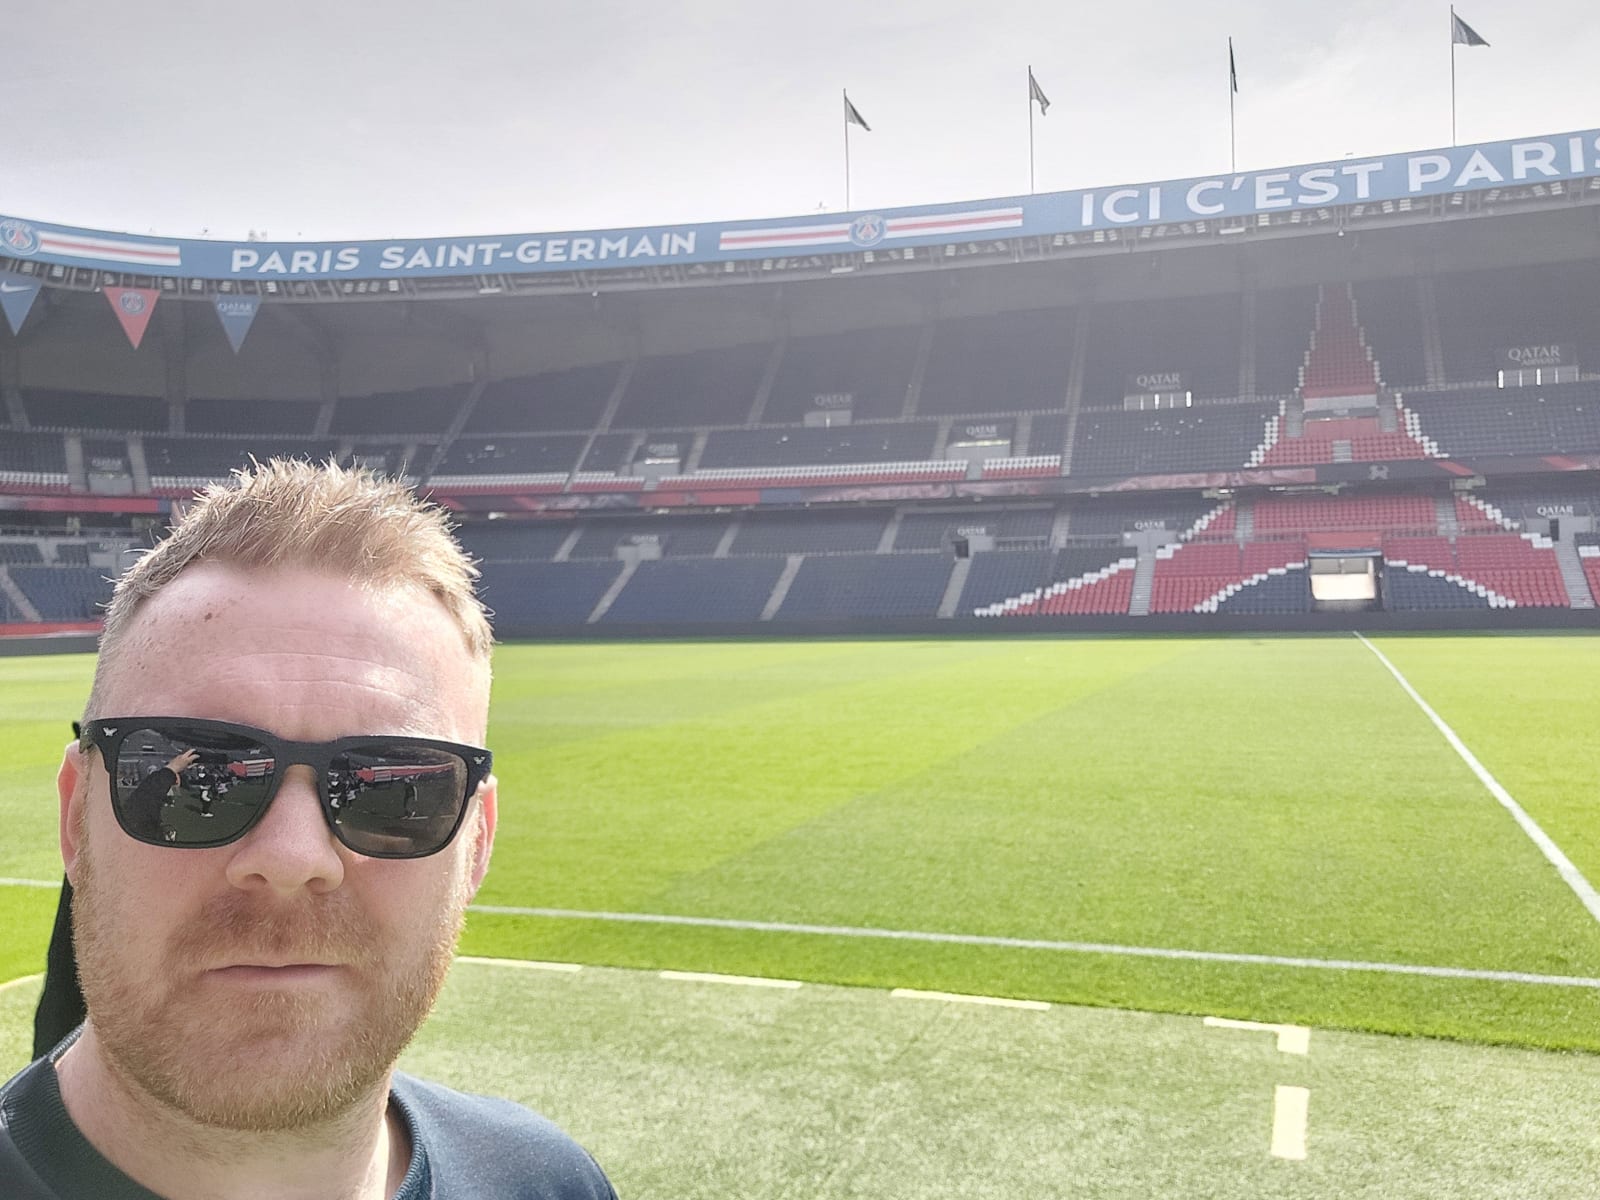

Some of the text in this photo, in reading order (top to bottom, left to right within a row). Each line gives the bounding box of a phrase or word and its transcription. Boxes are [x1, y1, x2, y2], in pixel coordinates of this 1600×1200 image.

[1081, 136, 1600, 226] ICI C'EST PARI
[231, 231, 697, 274] PARIS SAINT-GERMAIN
[1508, 345, 1560, 361] QATAR
[1136, 373, 1181, 387] QATAR
[1536, 505, 1574, 516] QATAR
[1134, 520, 1165, 530] QATAR
